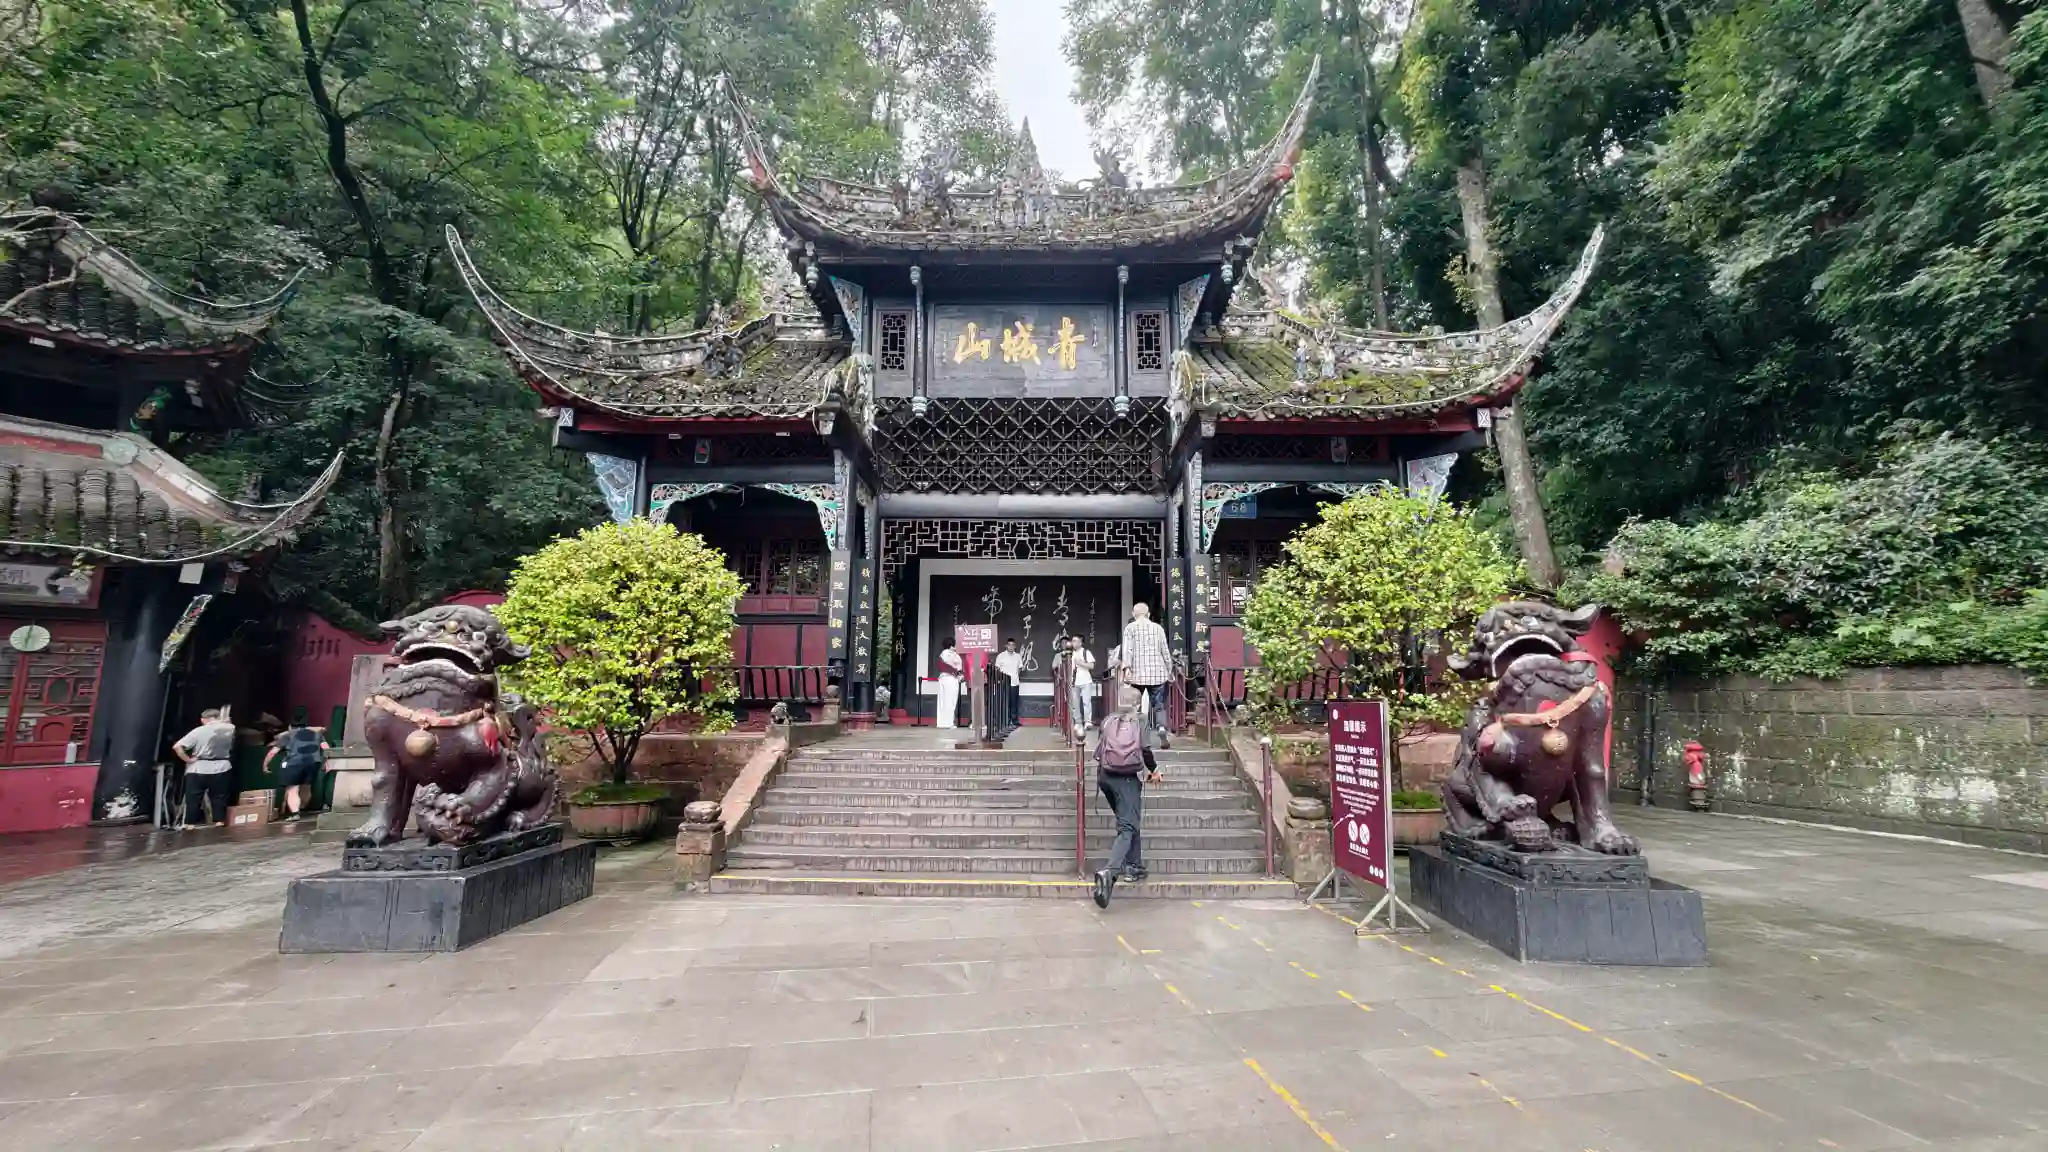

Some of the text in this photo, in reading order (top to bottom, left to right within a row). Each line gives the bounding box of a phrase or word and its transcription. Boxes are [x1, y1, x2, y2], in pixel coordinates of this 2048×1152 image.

[953, 316, 1086, 370] 青城山
[1231, 502, 1247, 513] 68
